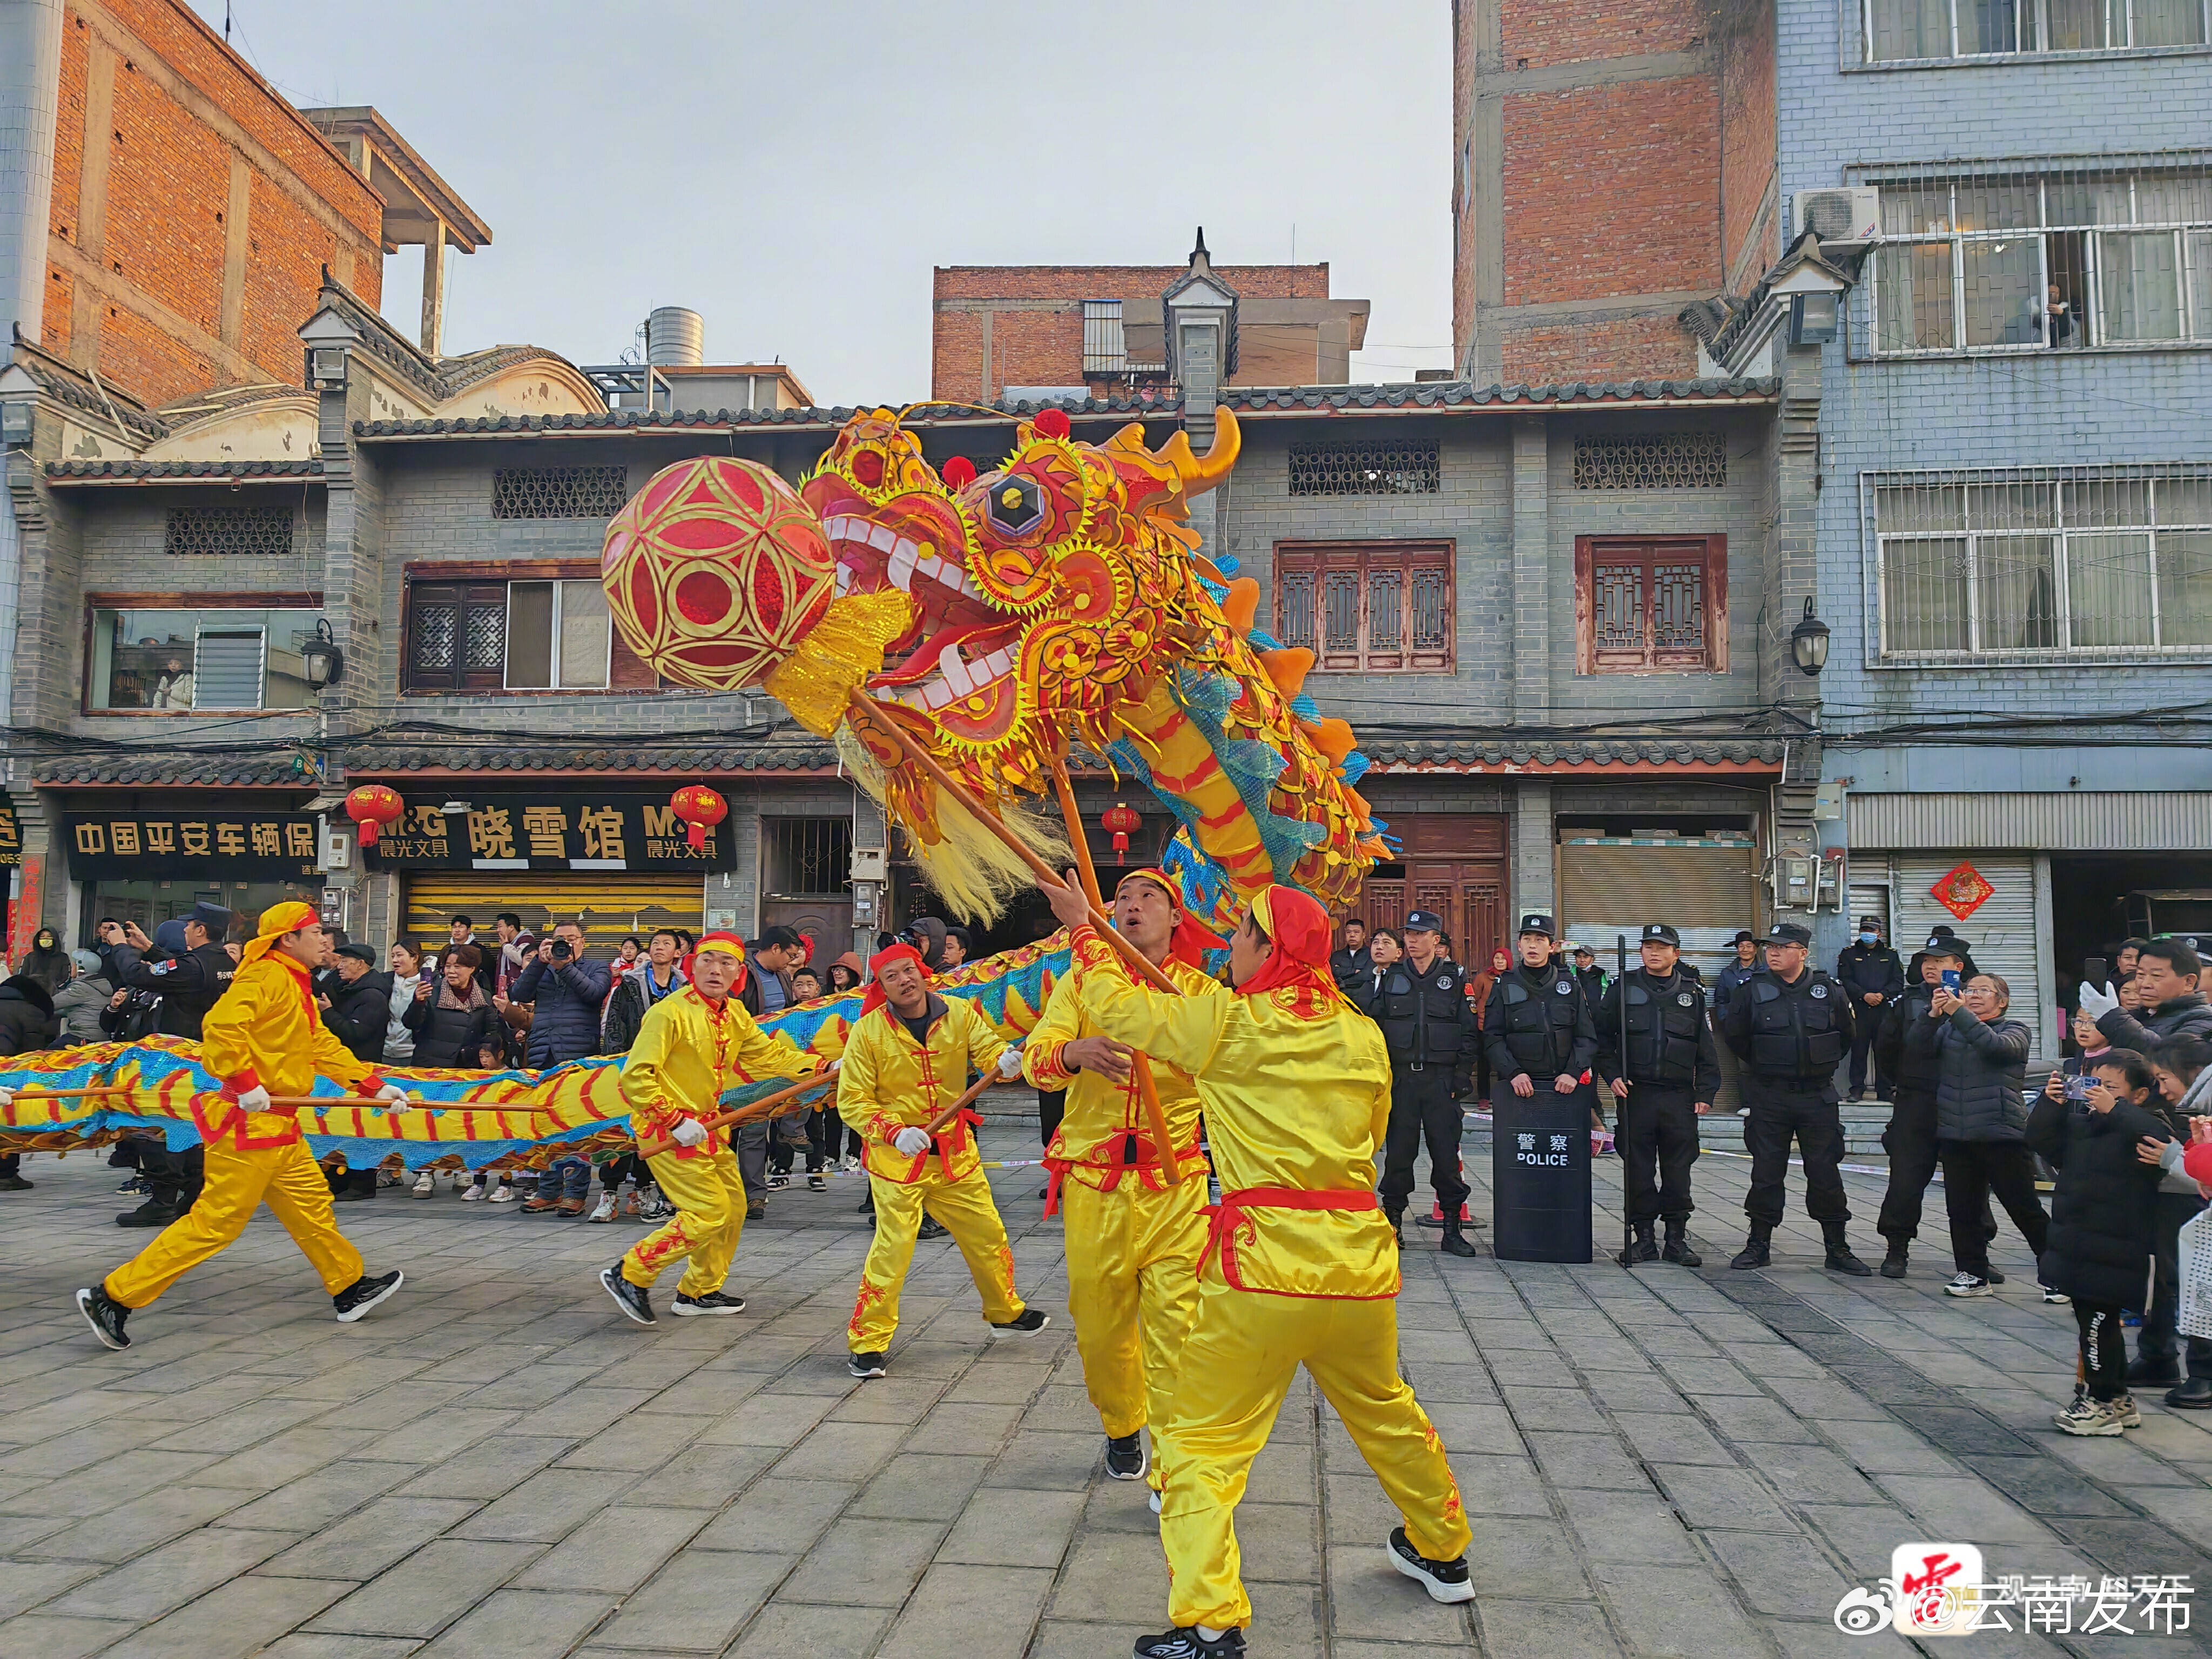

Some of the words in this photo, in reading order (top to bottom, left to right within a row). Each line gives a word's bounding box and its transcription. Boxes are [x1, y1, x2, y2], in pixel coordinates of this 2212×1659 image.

[75, 821, 315, 857] 中国平安车辆保
[467, 805, 626, 859] 晓雪馆
[379, 839, 450, 858] 晨光文具
[1516, 1133, 1568, 1151] 警察
[1516, 1153, 1568, 1166] POLICE
